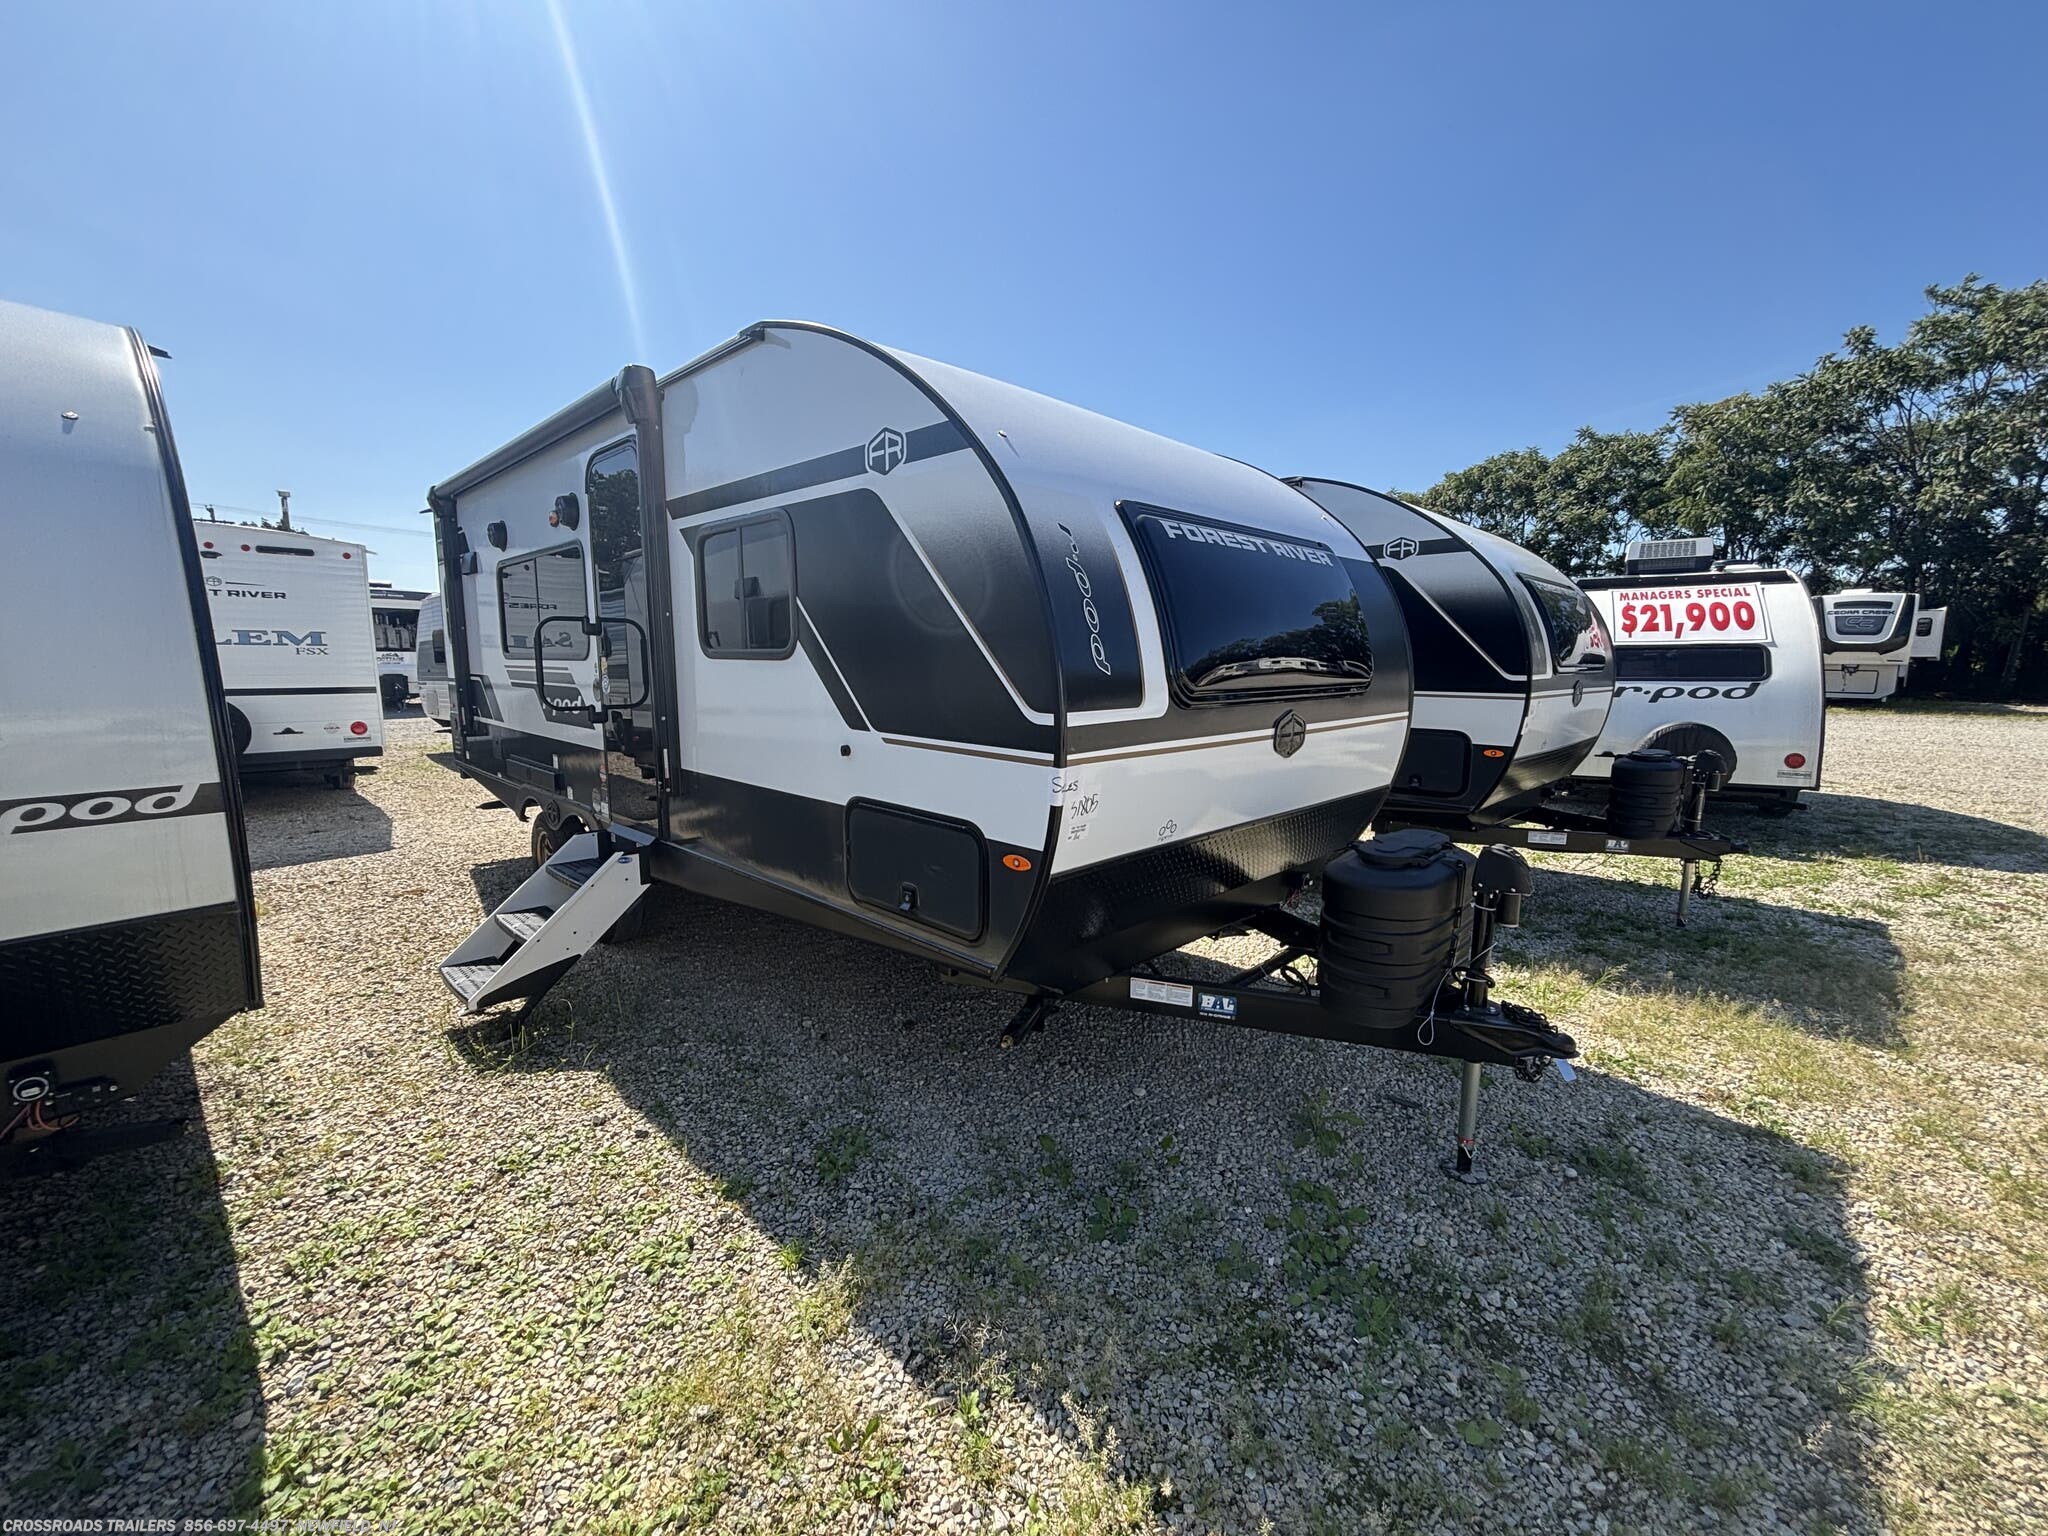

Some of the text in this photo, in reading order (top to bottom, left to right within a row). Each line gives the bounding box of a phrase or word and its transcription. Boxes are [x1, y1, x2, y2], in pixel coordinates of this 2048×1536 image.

[1158, 519, 1334, 567] FOREST RIVER
[226, 589, 287, 599] RIVER
[1619, 587, 1751, 601] MANAGERS SPECIAL
[1621, 601, 1755, 639] $21,900
[296, 647, 329, 656] FSX
[1201, 995, 1235, 1011] BAL
